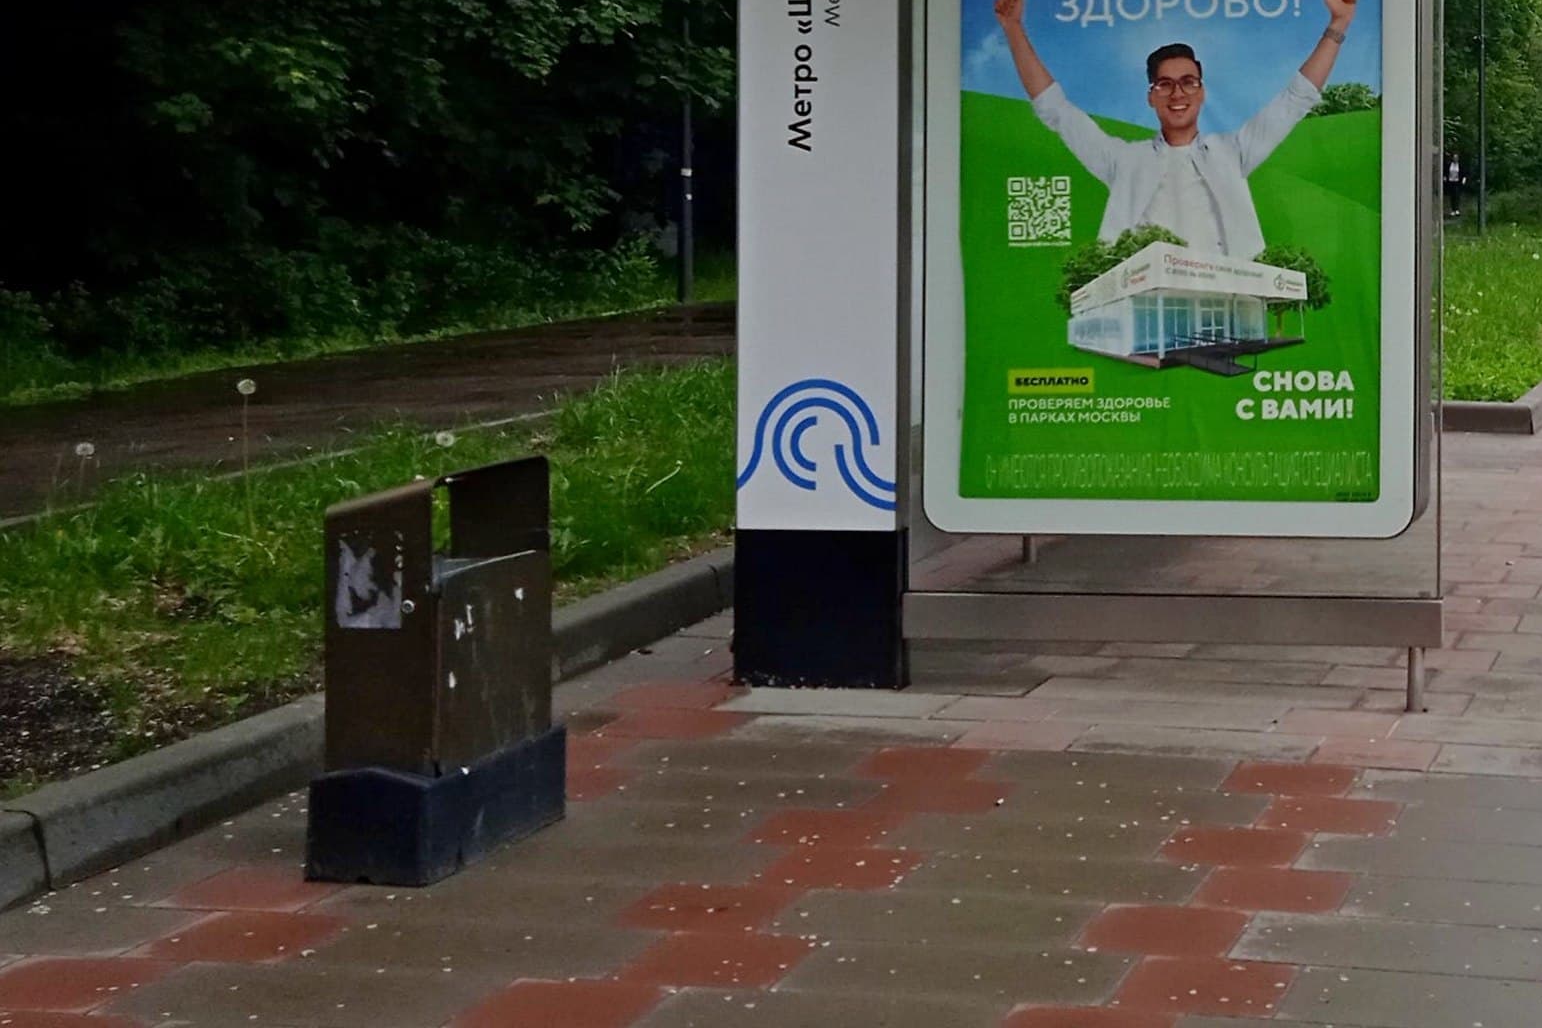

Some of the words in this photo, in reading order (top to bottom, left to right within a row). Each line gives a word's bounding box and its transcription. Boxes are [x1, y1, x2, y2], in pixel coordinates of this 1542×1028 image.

[788, 44, 818, 152] Метро
[1015, 376, 1089, 386] БЕСПЛАТНО
[1253, 370, 1354, 393] СНОВА
[1008, 398, 1093, 410] ПРОВЕРЯЕМ
[1097, 397, 1171, 410] ЗДОРОВЬЕ
[1235, 400, 1255, 420] С
[1261, 398, 1354, 420] ВАМИ!
[1008, 413, 1016, 424] В
[1020, 412, 1075, 424] ПАРКАХ
[1078, 412, 1141, 423] МОСКВЫ
